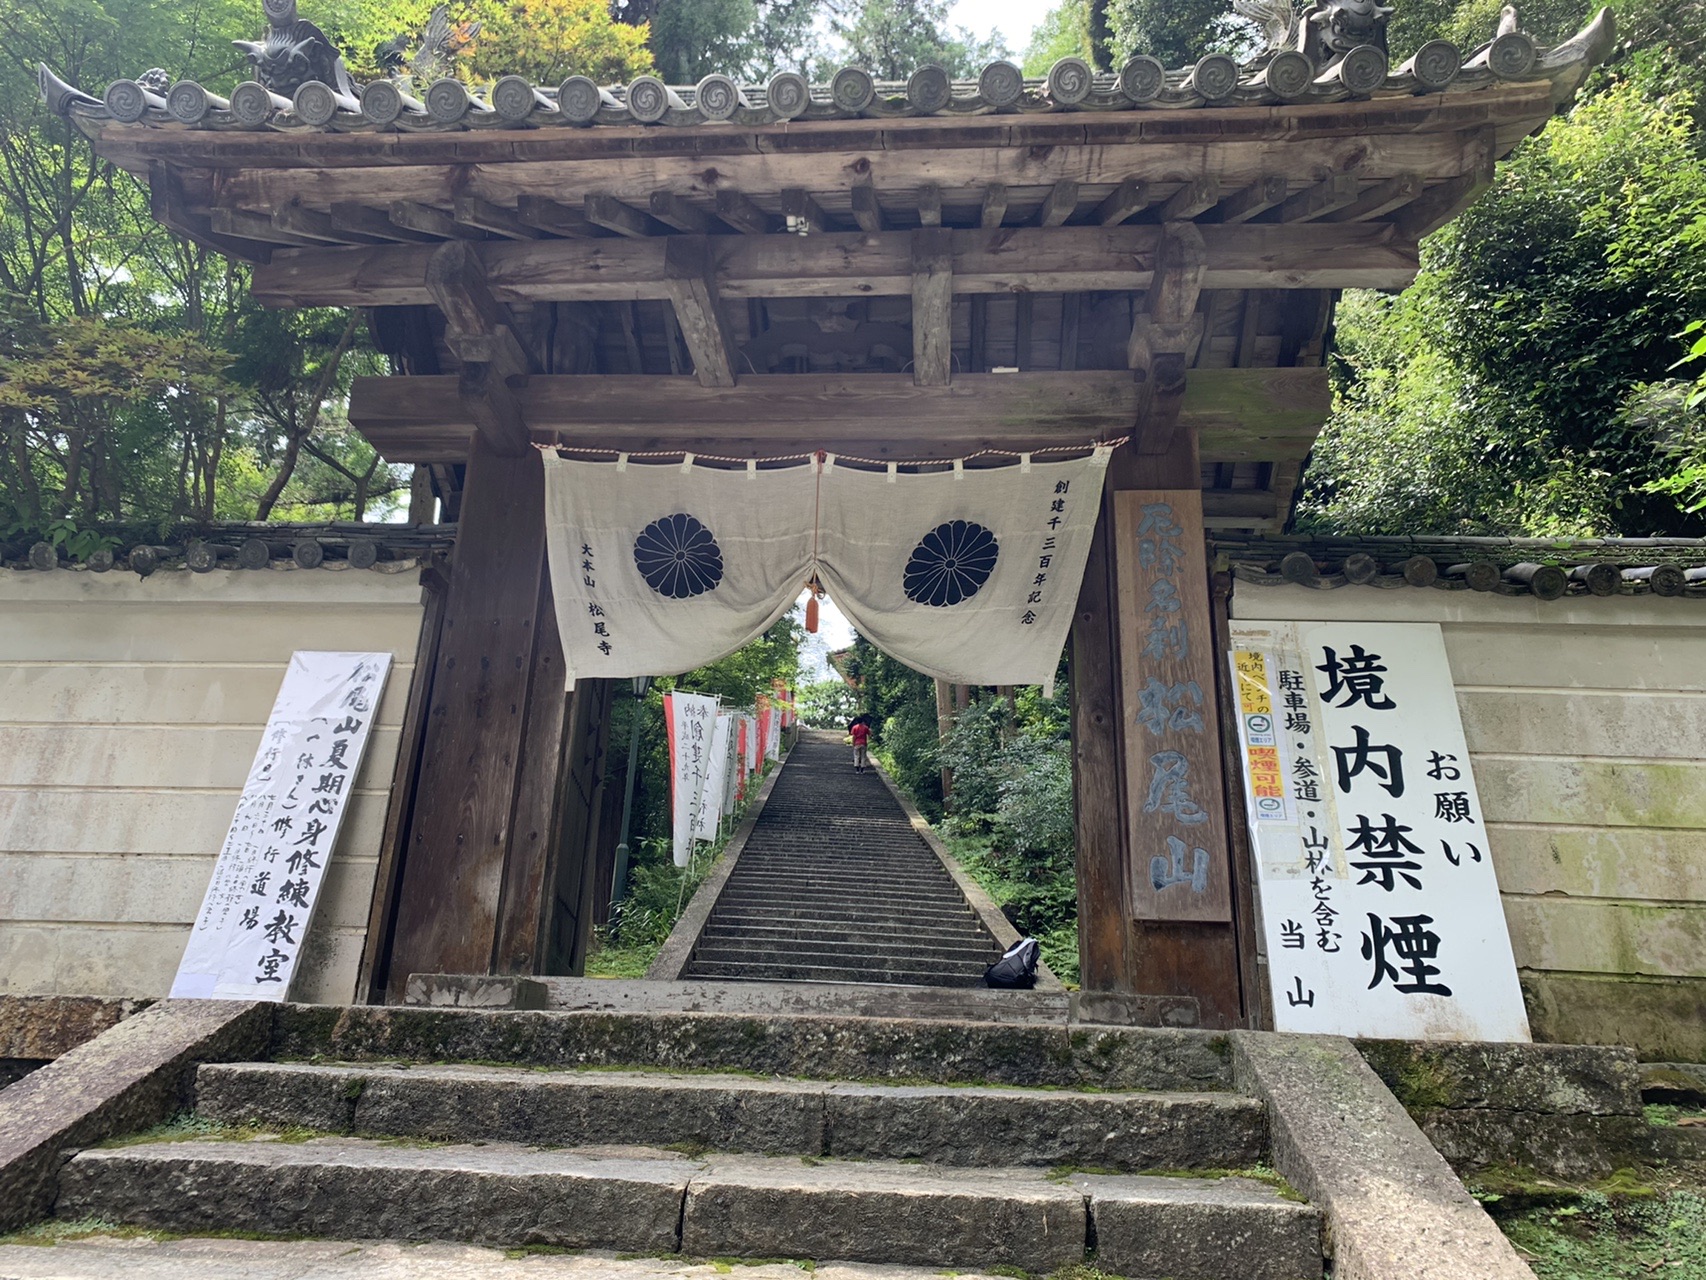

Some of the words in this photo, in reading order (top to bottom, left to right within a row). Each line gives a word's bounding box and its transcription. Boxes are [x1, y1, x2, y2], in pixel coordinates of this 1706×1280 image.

[580, 543, 597, 589] 大本山
[1019, 479, 1071, 626] 創建千三百年記念
[588, 602, 613, 657] 松尾寺
[1249, 747, 1282, 797] 喫煙可能
[1279, 669, 1343, 953] 駐車場・参道・山林を含む
[1315, 644, 1453, 997] 境内禁煙
[1427, 750, 1483, 867] お願い
[1281, 918, 1315, 1008] 当山
